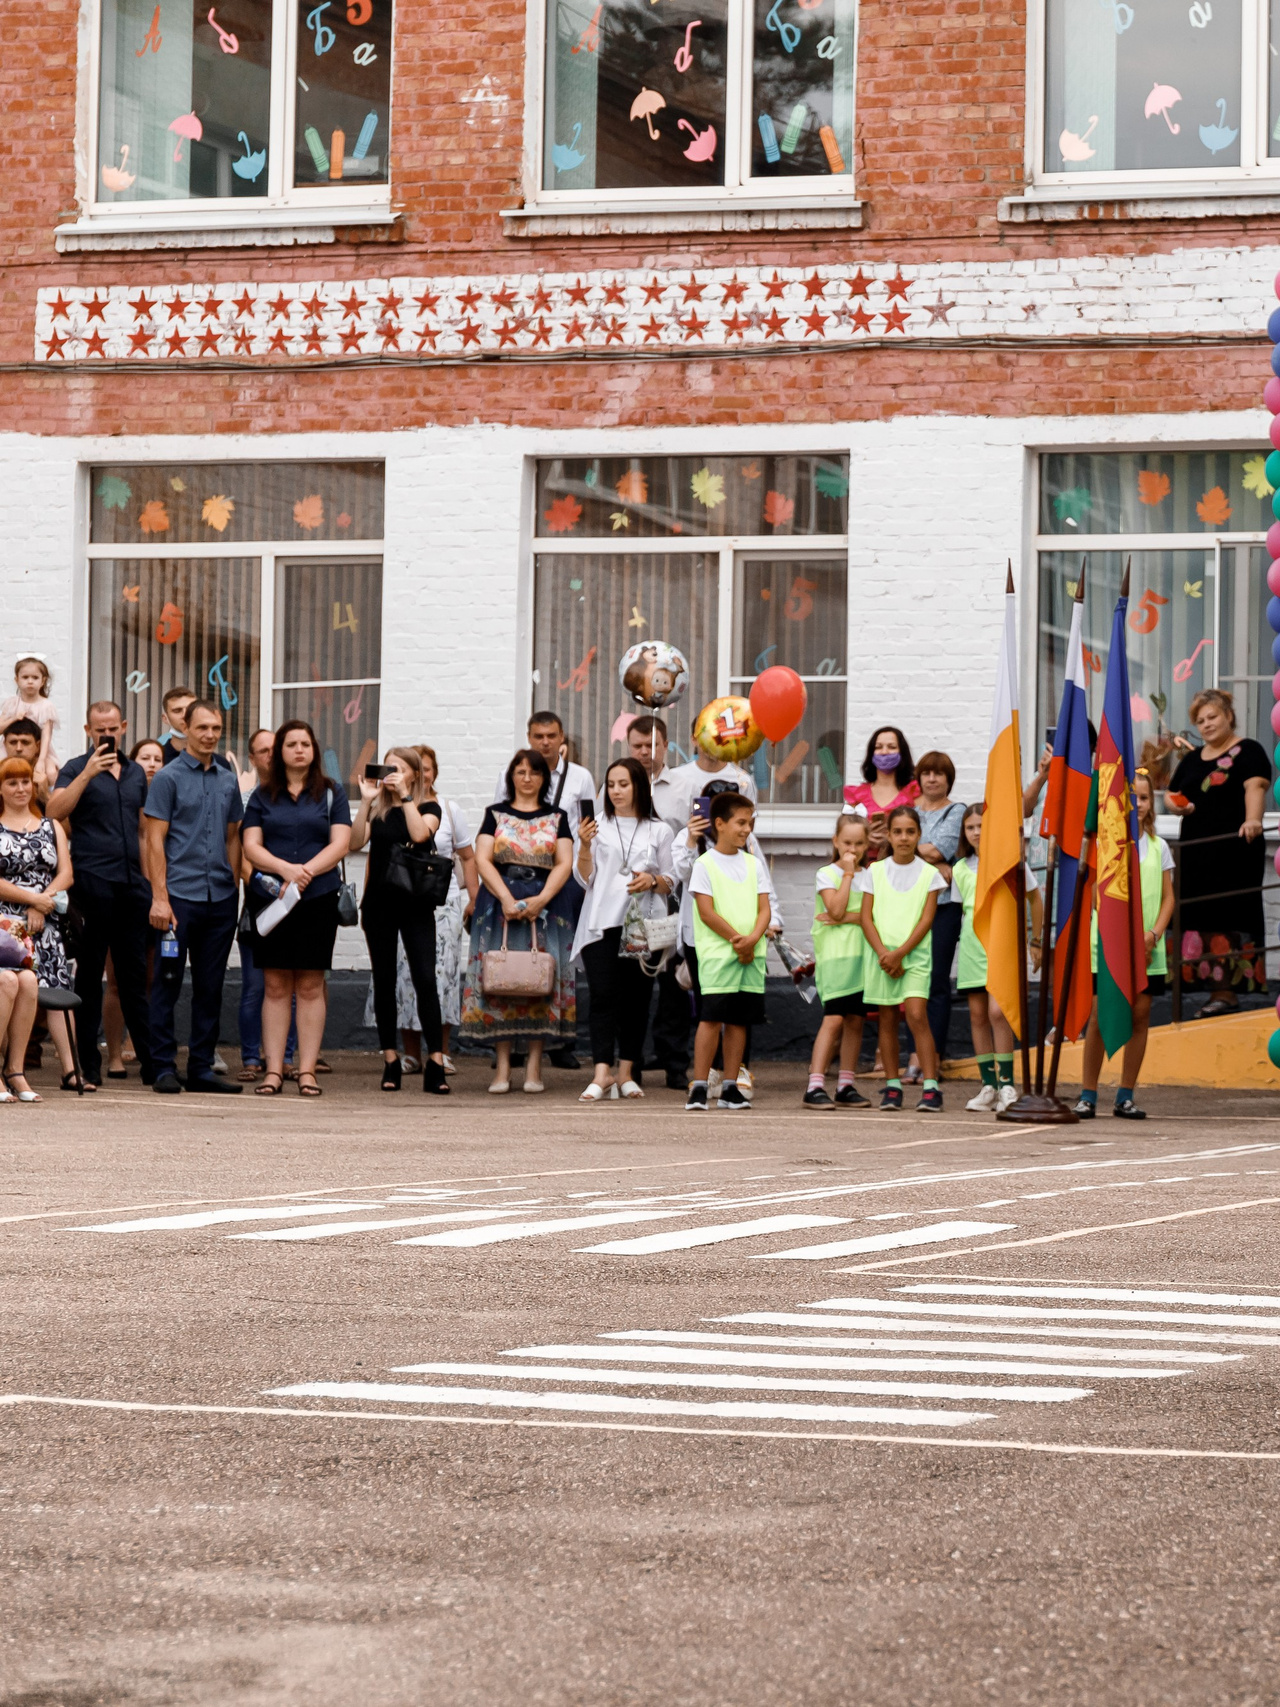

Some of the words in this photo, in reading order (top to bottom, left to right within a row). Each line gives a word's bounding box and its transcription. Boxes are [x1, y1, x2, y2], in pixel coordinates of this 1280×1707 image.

[333, 601, 358, 633] 4
[783, 576, 817, 621] 5
[1129, 588, 1169, 634] 5
[719, 707, 735, 729] 1
